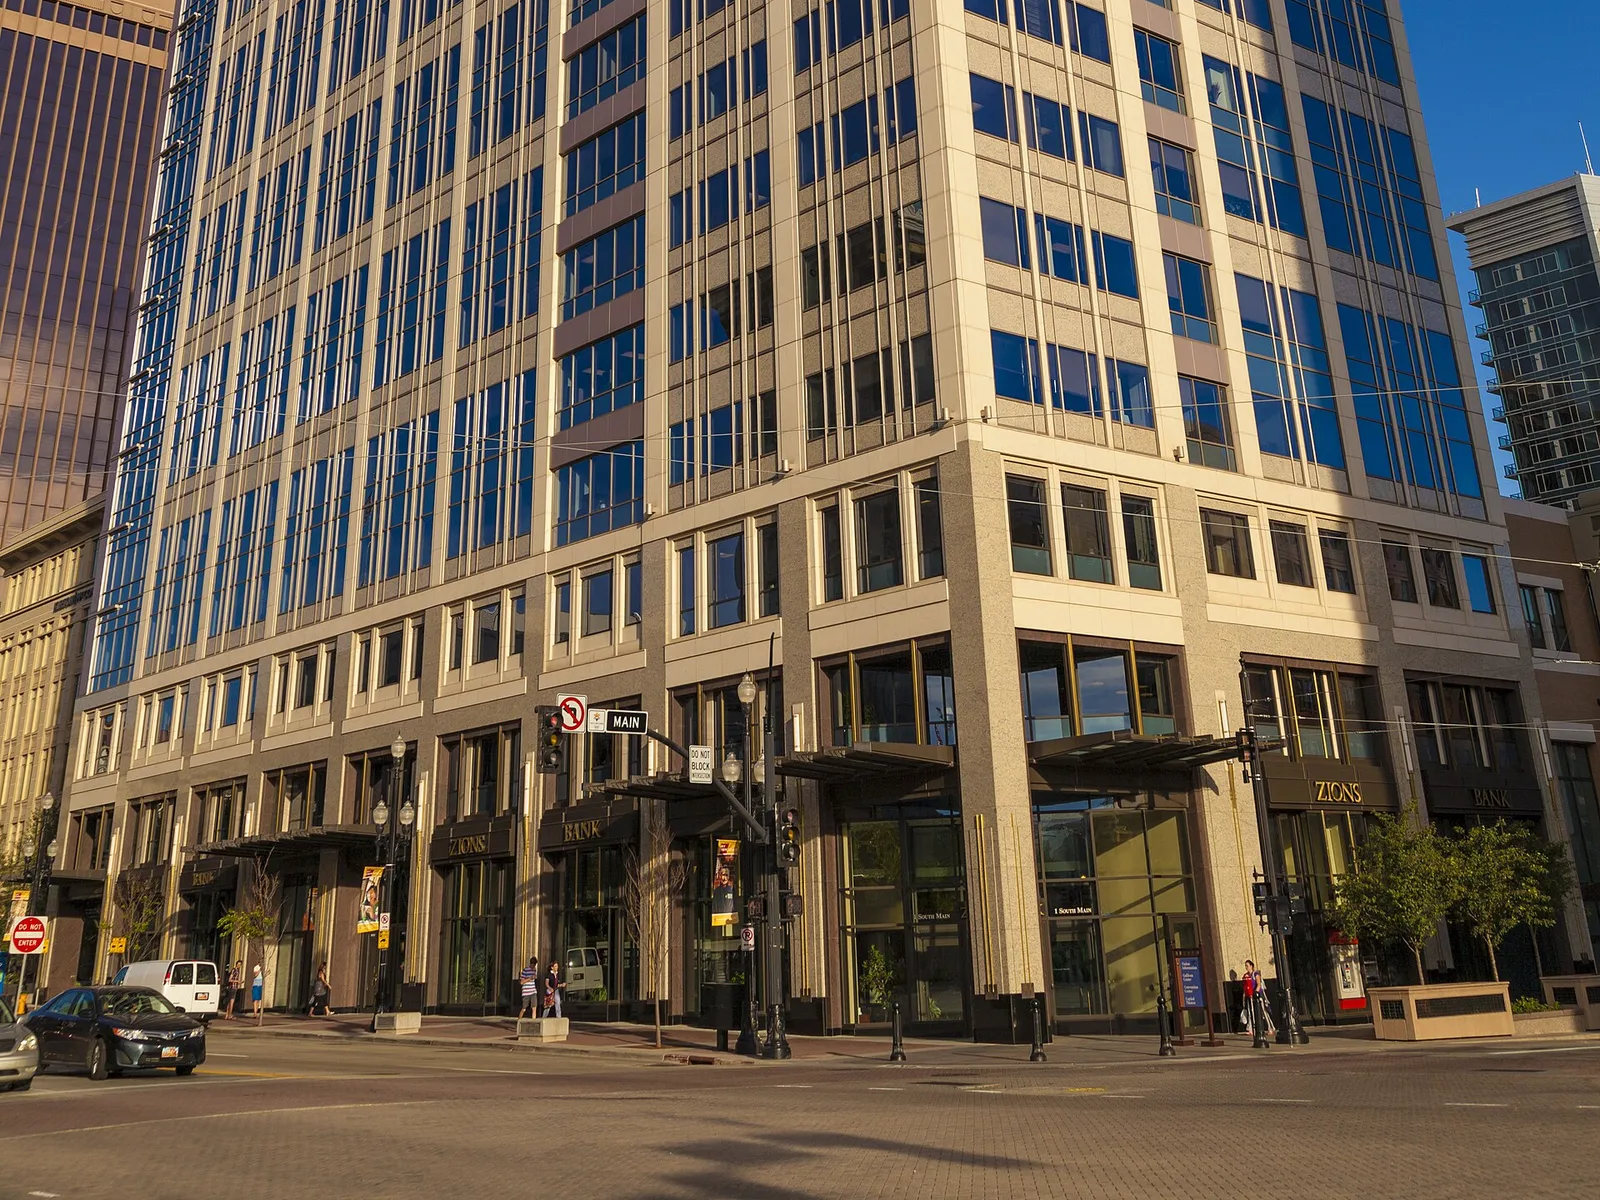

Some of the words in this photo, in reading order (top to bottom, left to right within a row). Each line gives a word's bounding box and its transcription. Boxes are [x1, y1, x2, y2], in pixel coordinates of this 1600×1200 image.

[614, 716, 639, 728] MAIN
[692, 750, 699, 759] DO
[700, 750, 710, 759] NOT
[691, 761, 710, 771] BLOCK
[1315, 781, 1362, 803] ZIONS
[1474, 788, 1512, 808] BANK
[563, 819, 602, 843] BANK
[450, 834, 488, 856] ZIONS
[18, 923, 28, 931] DO
[30, 923, 42, 931] NOT
[18, 939, 37, 947] ENTER
